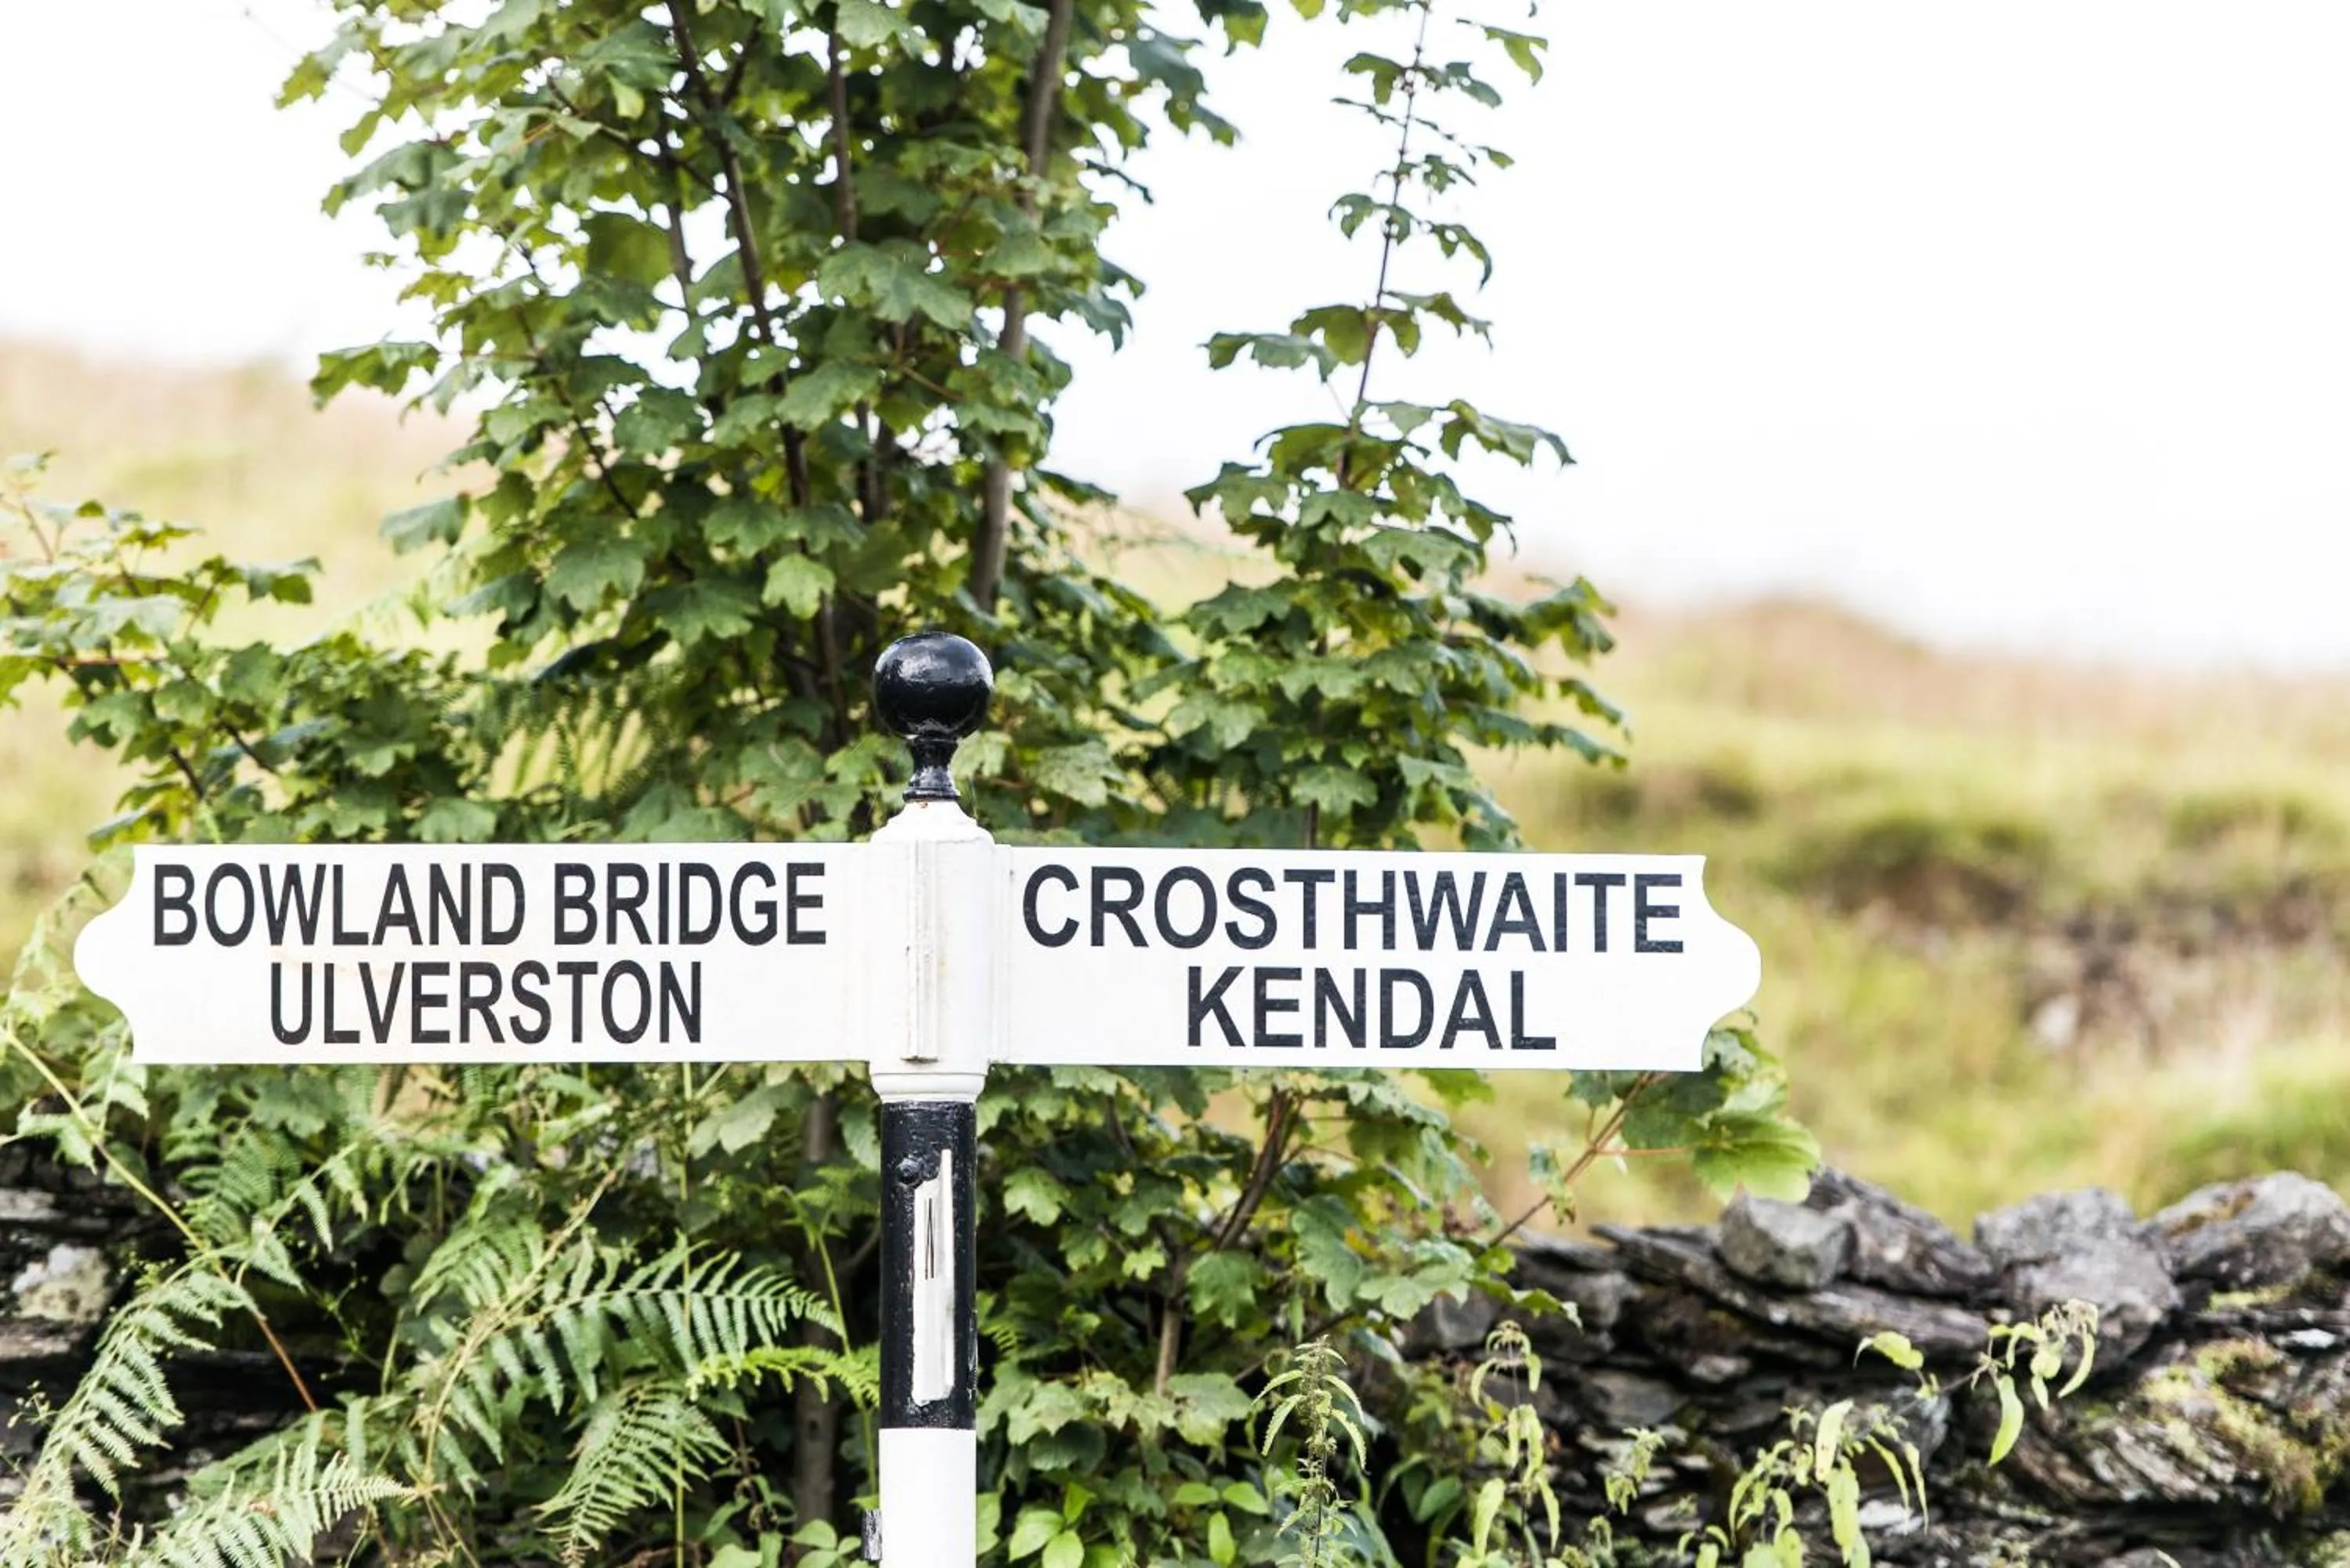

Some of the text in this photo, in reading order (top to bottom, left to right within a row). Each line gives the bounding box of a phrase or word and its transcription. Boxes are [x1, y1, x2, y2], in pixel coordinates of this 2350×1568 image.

[154, 861, 826, 947] BOWLAND BRIDGE
[1022, 864, 1683, 954] CROSTHWAITE
[271, 959, 701, 1046] ULVERSTON
[1188, 966, 1556, 1050] KENDAL
